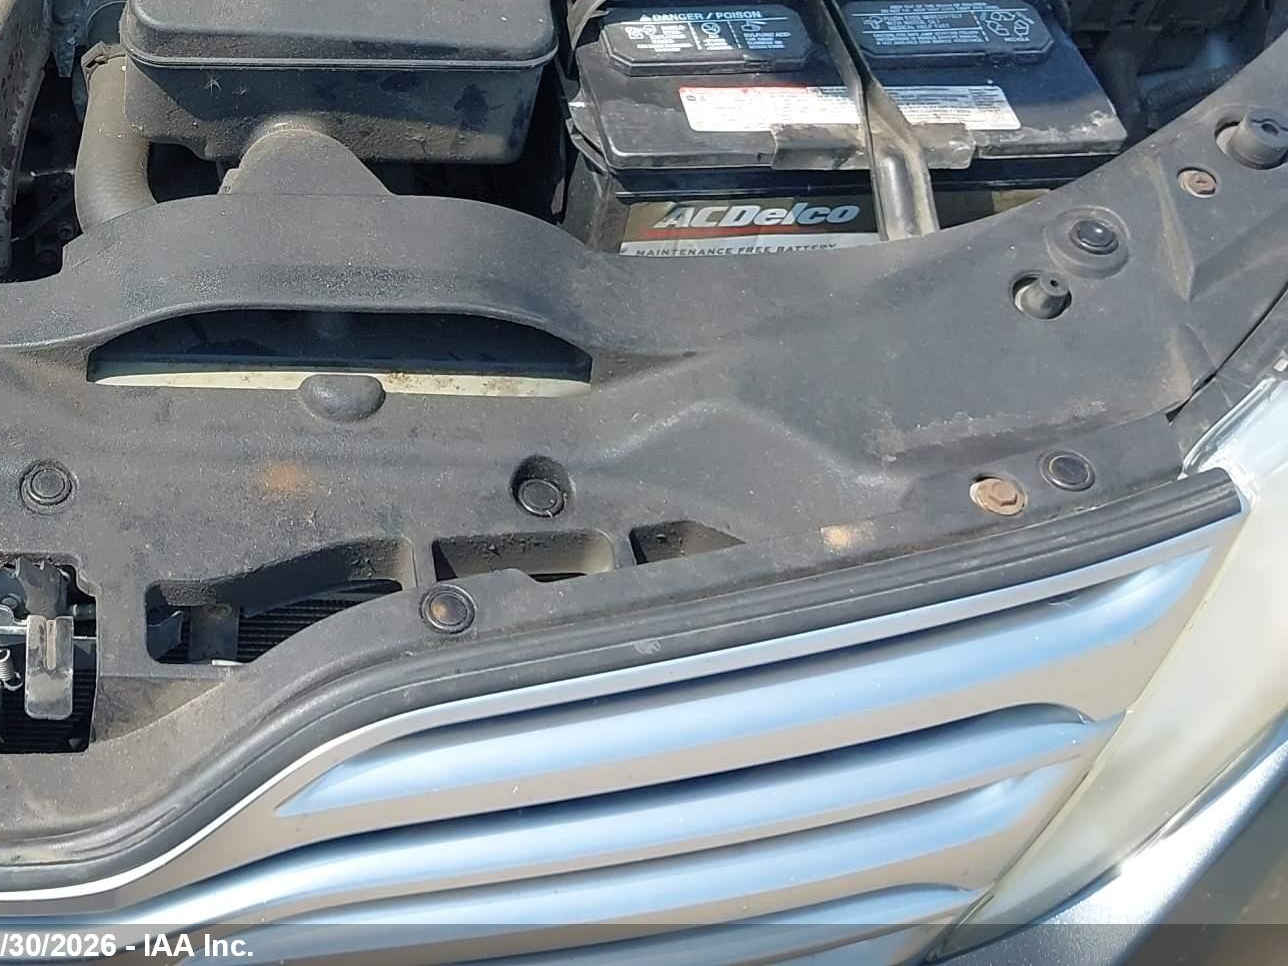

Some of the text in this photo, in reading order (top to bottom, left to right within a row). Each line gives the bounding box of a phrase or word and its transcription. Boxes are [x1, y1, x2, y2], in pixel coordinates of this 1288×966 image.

[652, 13, 703, 22] DANGER
[716, 10, 762, 20] POISON
[653, 202, 861, 229] ACDelco
[636, 247, 733, 257] MAINTENANCE
[739, 245, 772, 254] FREE
